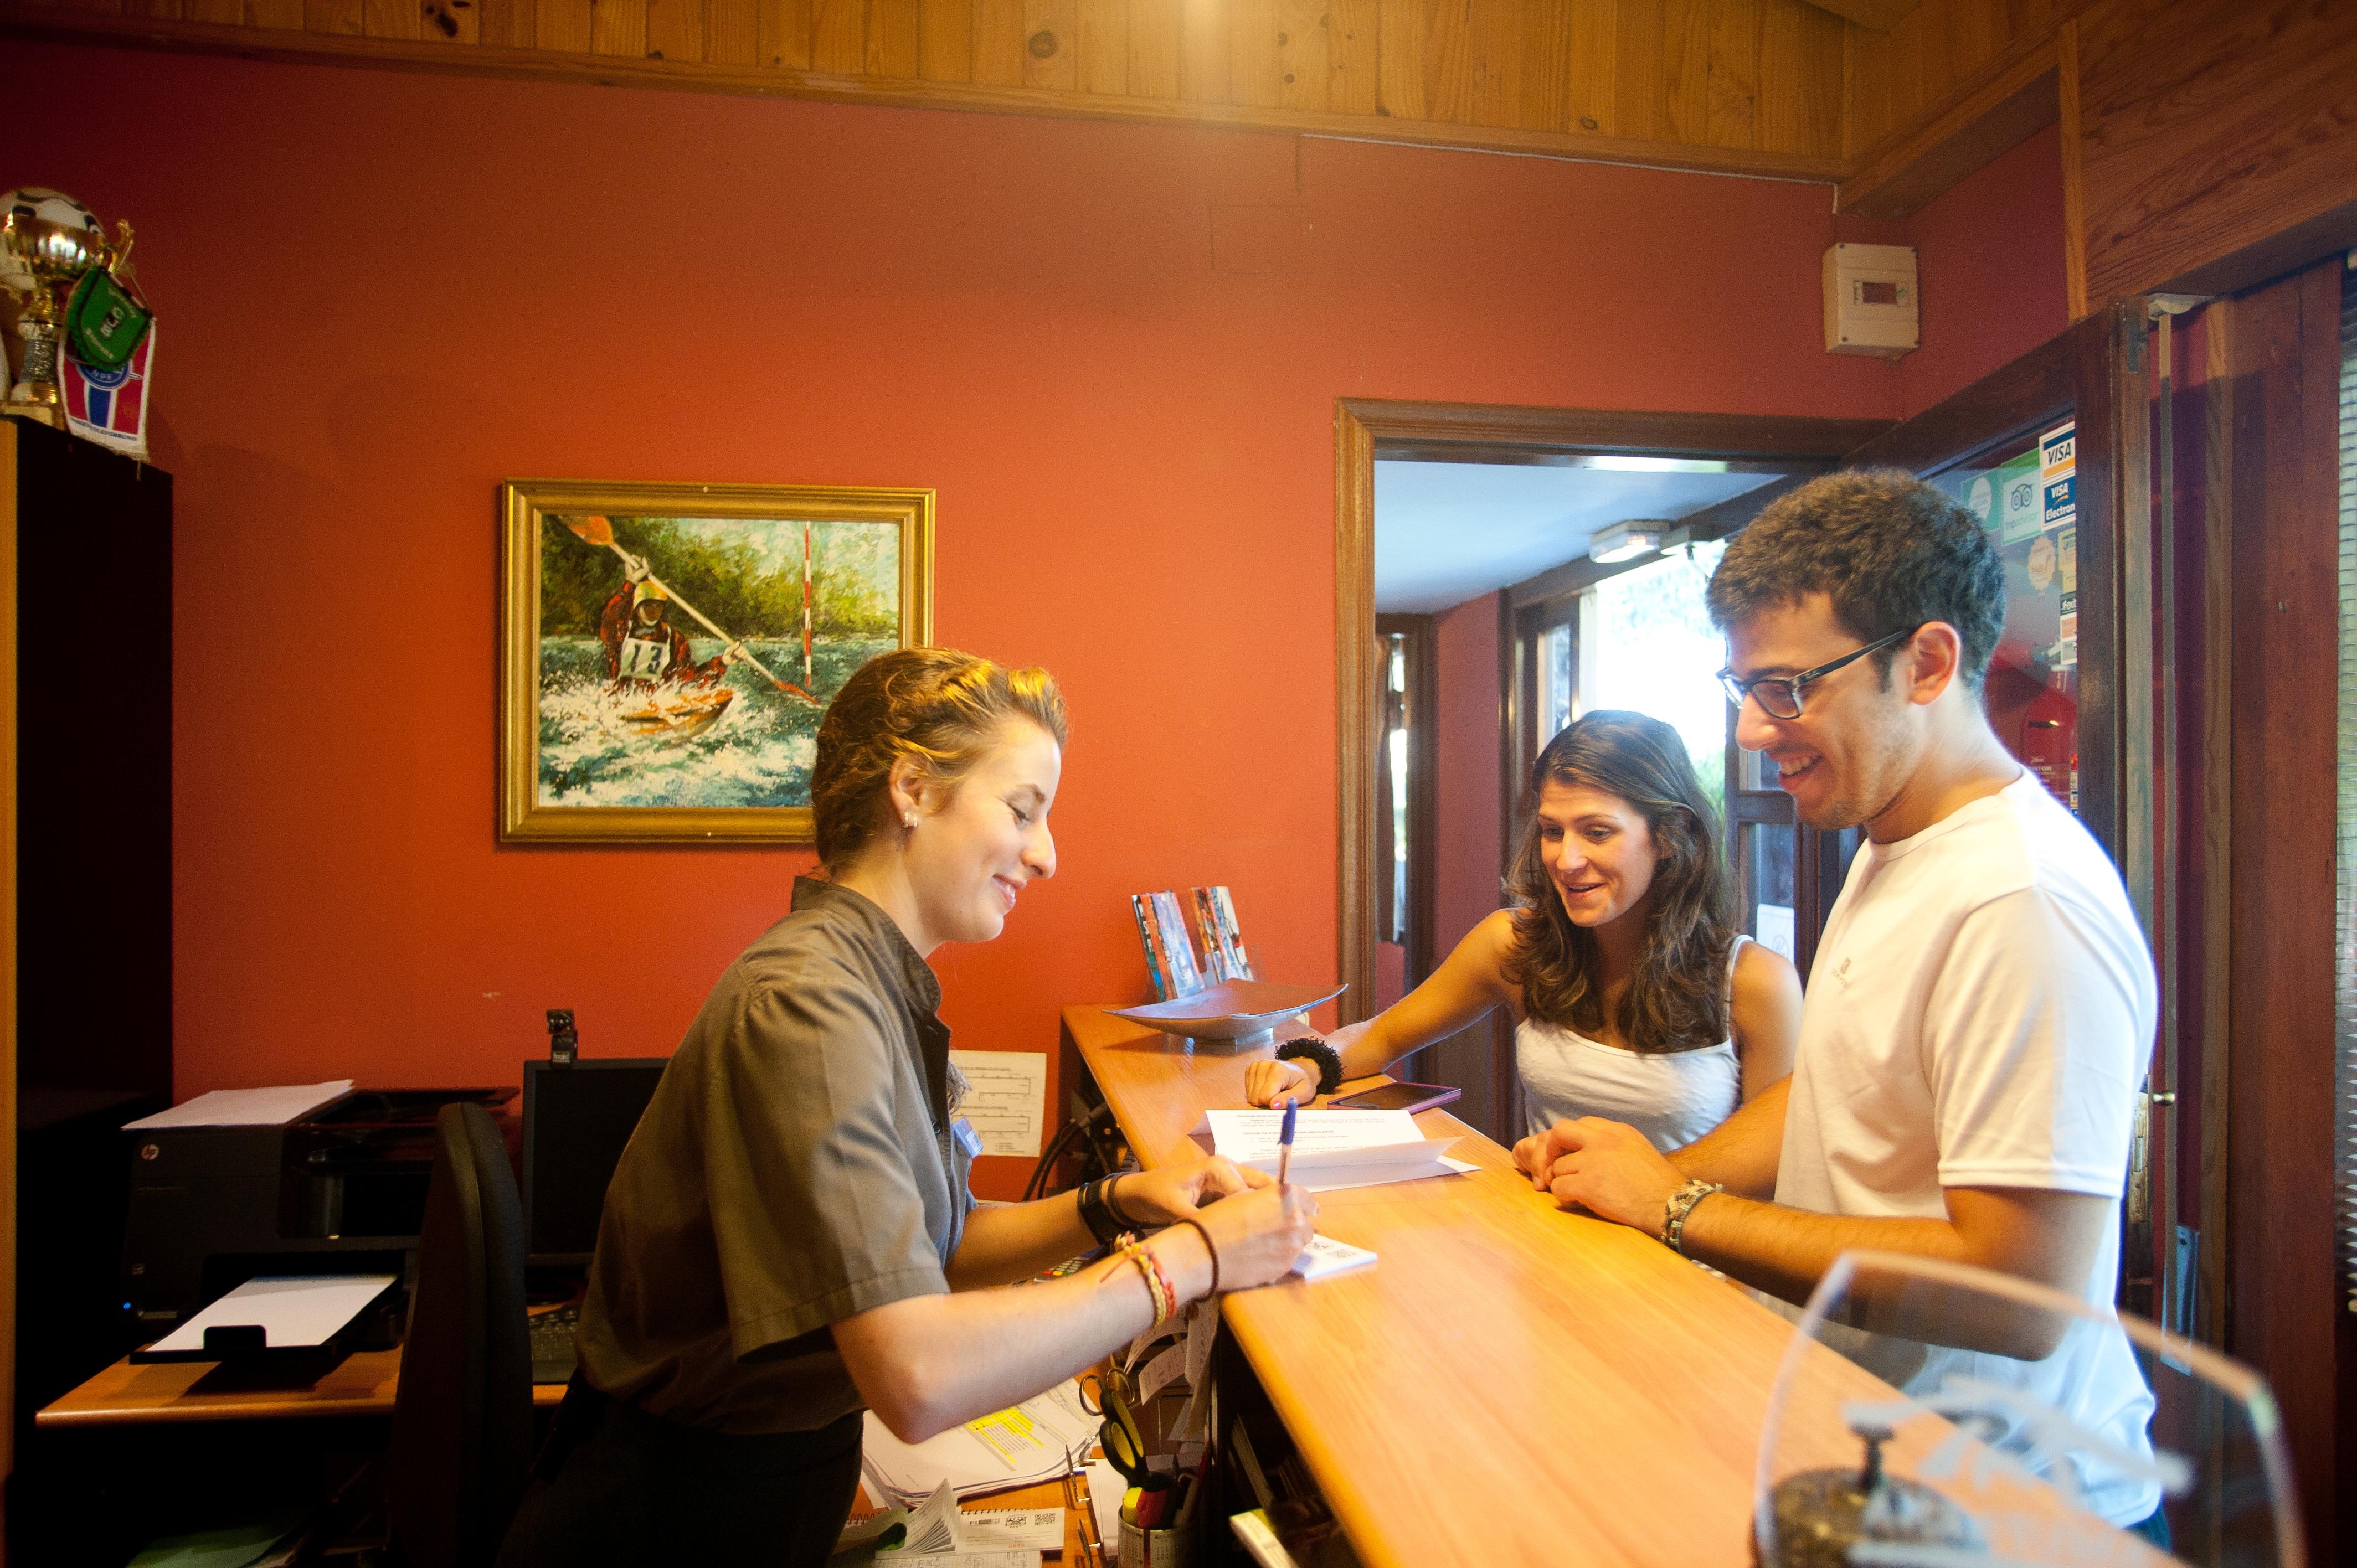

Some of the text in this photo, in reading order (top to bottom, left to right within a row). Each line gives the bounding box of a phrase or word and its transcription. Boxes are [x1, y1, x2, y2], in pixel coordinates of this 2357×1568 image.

[2047, 442, 2071, 465] VISA
[2051, 483, 2068, 498] VISA
[2046, 503, 2076, 520] Electron
[631, 644, 662, 674] 13
